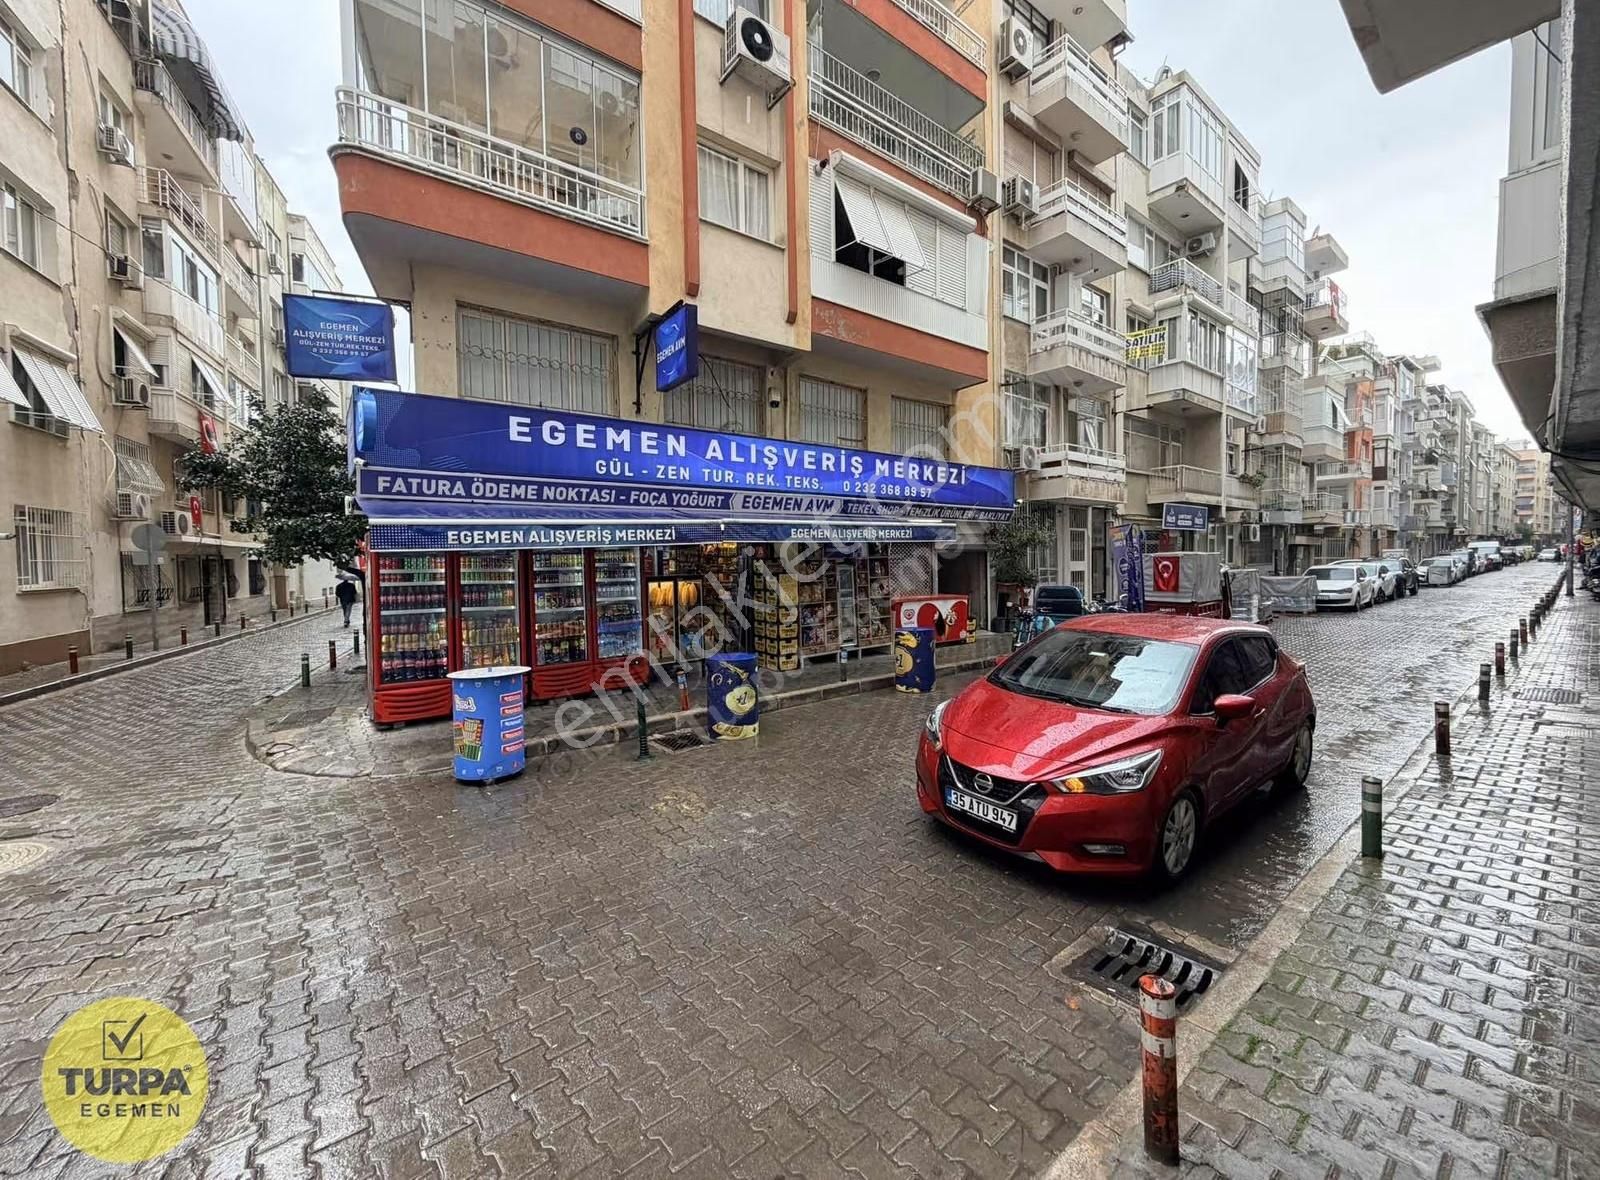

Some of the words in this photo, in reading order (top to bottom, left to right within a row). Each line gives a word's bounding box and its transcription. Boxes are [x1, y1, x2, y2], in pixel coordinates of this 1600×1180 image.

[320, 322, 358, 332] EGEMEN
[293, 329, 343, 342] ALIŞVERİŞ
[345, 335, 385, 344] MERKEZİ
[1125, 331, 1166, 348] SATILIK
[657, 344, 675, 364] EGEMEN
[509, 415, 687, 457] EGEMEN
[705, 439, 863, 479] ALIŞVERİŞ
[875, 458, 967, 485] MERKEZİ
[596, 459, 634, 477] GÜL
[656, 466, 690, 480] ZEN
[702, 469, 740, 485] TUR.
[746, 473, 780, 487] REK.
[786, 476, 824, 490] TEKS.
[843, 481, 850, 492] 0
[855, 482, 877, 494] 232
[880, 483, 901, 496] 368
[920, 487, 932, 498] 57
[377, 475, 466, 496] FATURA
[471, 477, 538, 500] ÖDEME
[542, 486, 616, 503] NOKTASI
[630, 490, 668, 506] FOÇA
[672, 492, 725, 508] YOĞURT
[741, 495, 802, 511] EGEMEN
[804, 498, 834, 513] AVM
[847, 503, 875, 515] TEKEL
[876, 504, 899, 516] SHOP
[447, 530, 524, 544] EGEMEN
[529, 527, 612, 545] ALIŞVERİŞ
[615, 527, 676, 541] MERKEZİ
[791, 528, 830, 539] EGEMEN
[832, 527, 877, 541] ALIŞVERİŞ
[879, 530, 913, 539] MERKEZİ
[952, 792, 966, 808] 35
[968, 798, 989, 817] ATU
[992, 807, 1014, 826] 947
